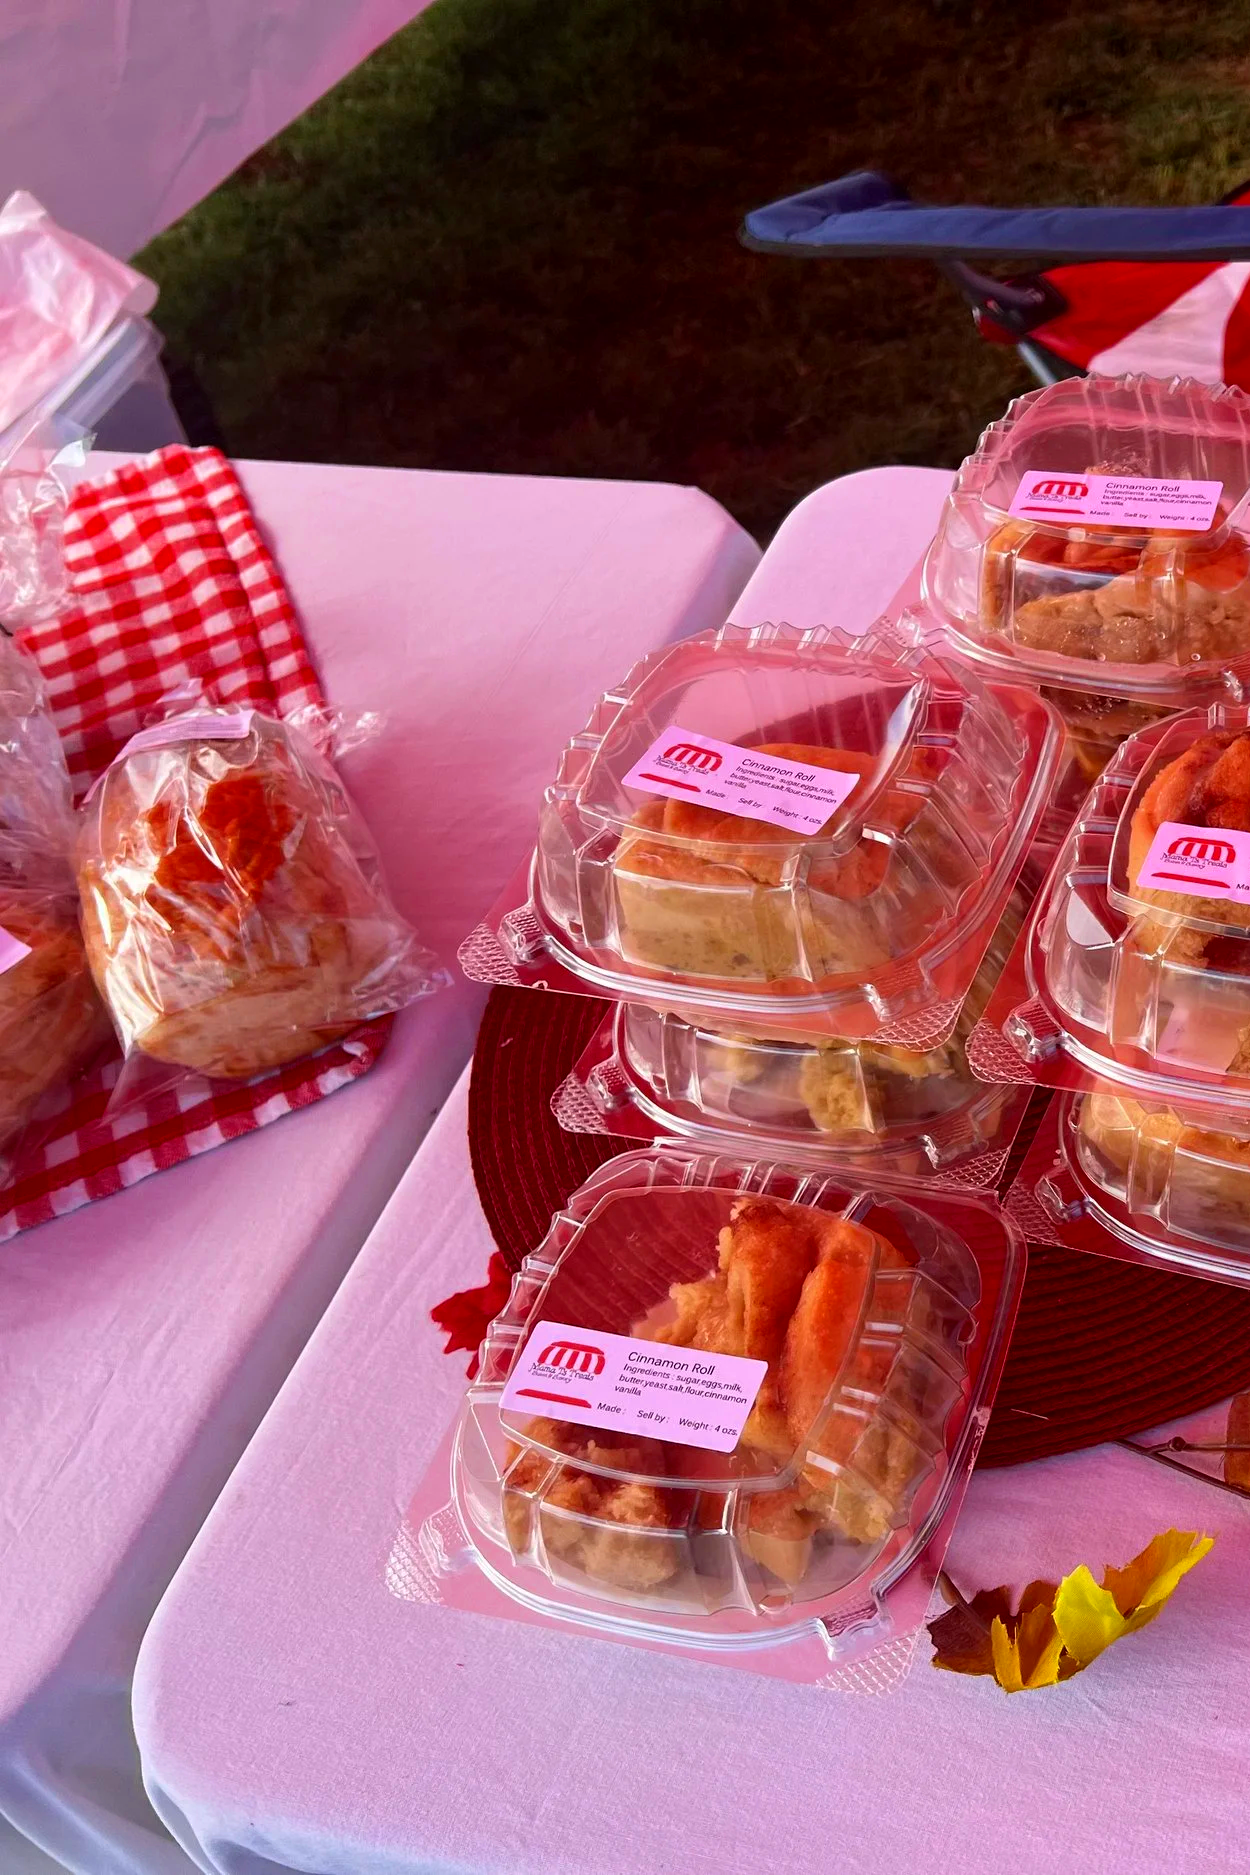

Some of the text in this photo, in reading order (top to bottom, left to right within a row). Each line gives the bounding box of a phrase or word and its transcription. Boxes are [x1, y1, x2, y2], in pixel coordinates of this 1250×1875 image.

[1106, 482, 1158, 491] Cinnamon
[736, 766, 776, 780] Ingredients
[742, 759, 816, 782] Cinnamon Roll
[706, 789, 726, 798] Made
[738, 798, 753, 806] Sell
[773, 806, 799, 818] Weight
[623, 1364, 671, 1379] Ingredients
[628, 1351, 716, 1376] Cinnamon Roll
[614, 1385, 642, 1396] vanilla
[597, 1402, 622, 1413] Made
[636, 1410, 654, 1420] Sell
[654, 1413, 666, 1424] by
[679, 1418, 709, 1431] Weight
